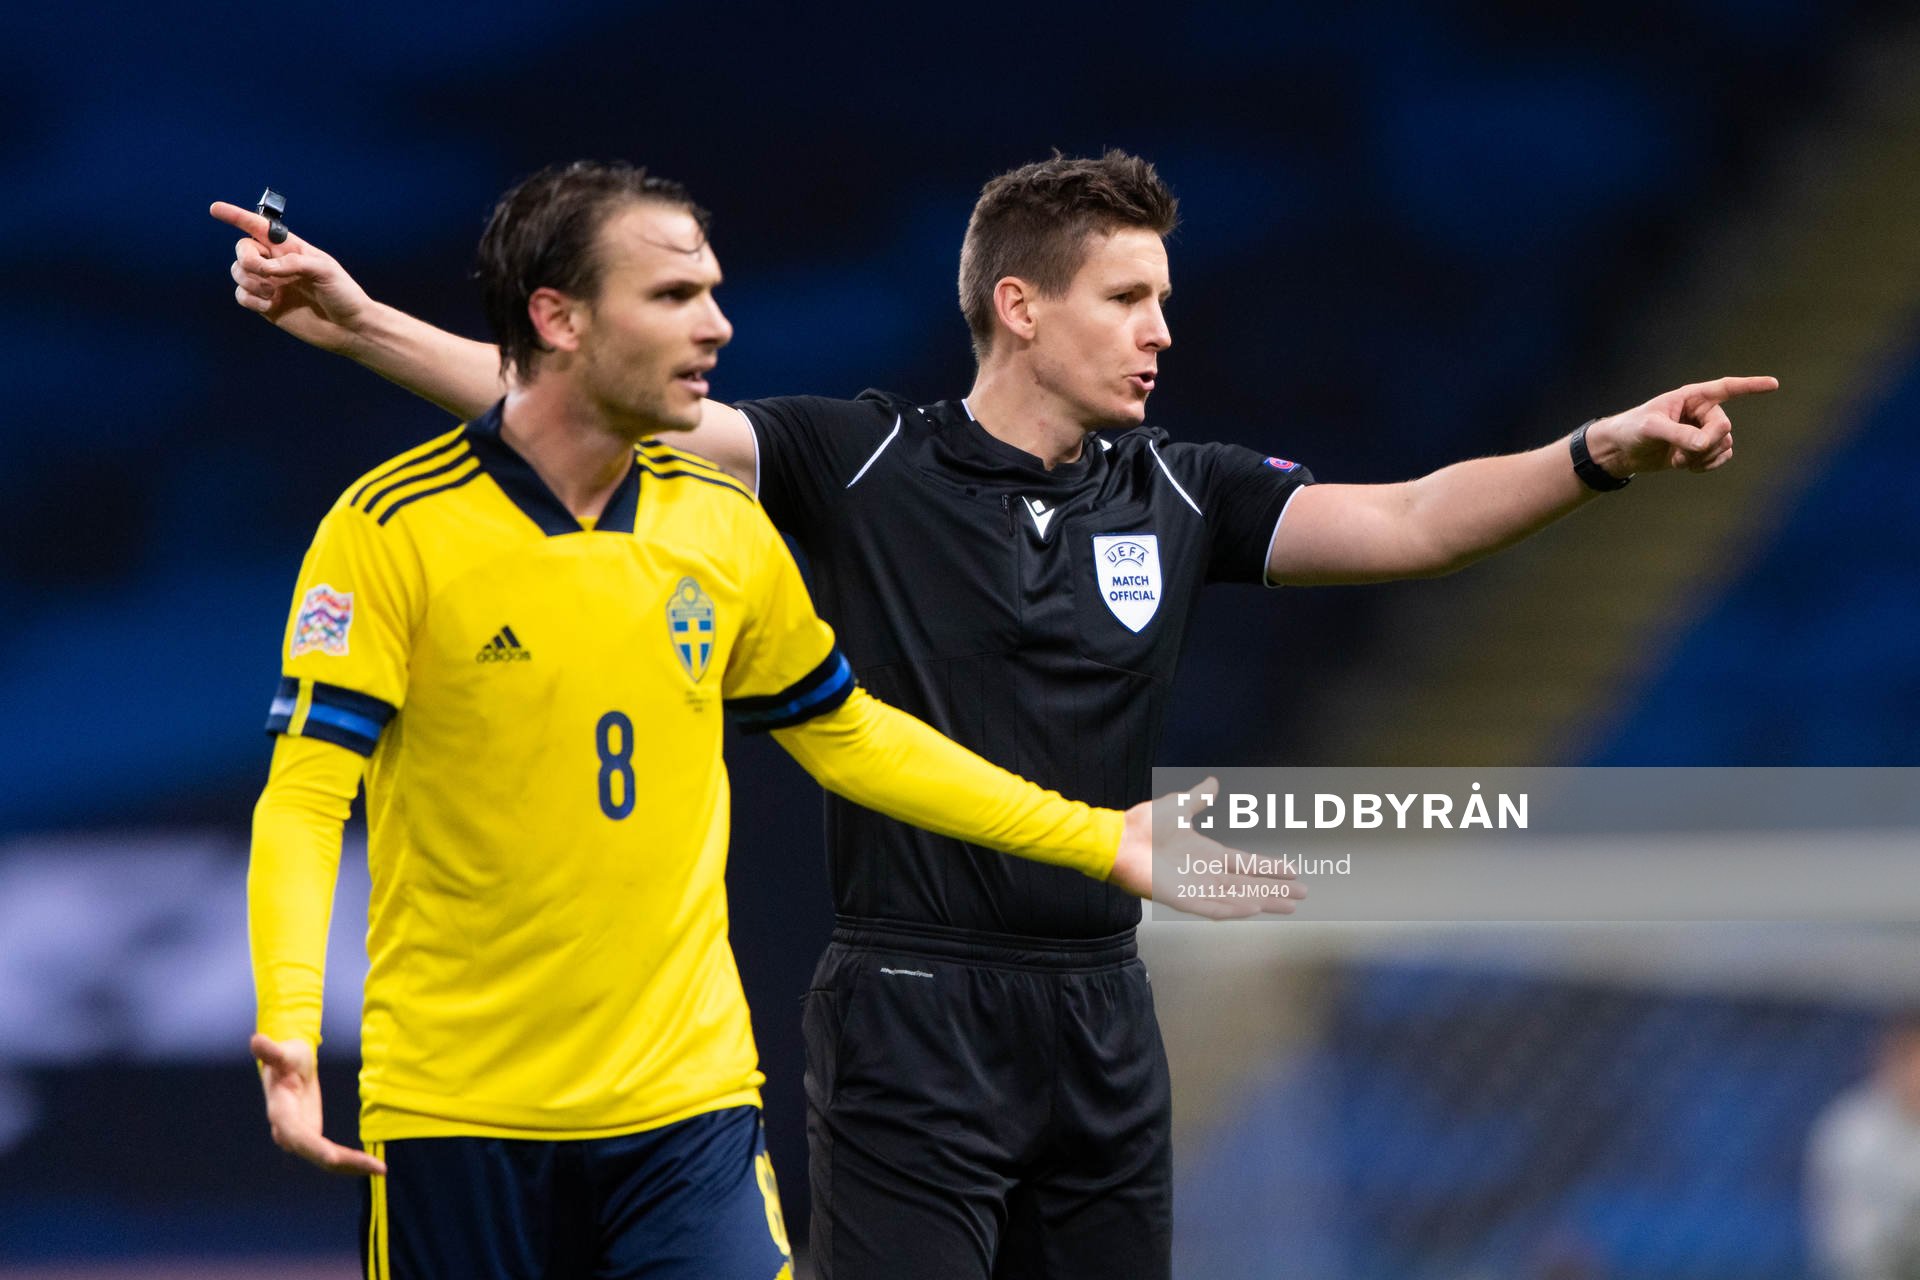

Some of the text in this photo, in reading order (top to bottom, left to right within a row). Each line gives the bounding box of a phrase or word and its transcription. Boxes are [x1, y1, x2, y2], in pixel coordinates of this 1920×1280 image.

[1107, 546, 1145, 563] UEFA
[1112, 575, 1149, 587] MATCH
[1109, 590, 1156, 602] OFFICIAL
[476, 650, 532, 664] adidas
[595, 710, 636, 821] 8
